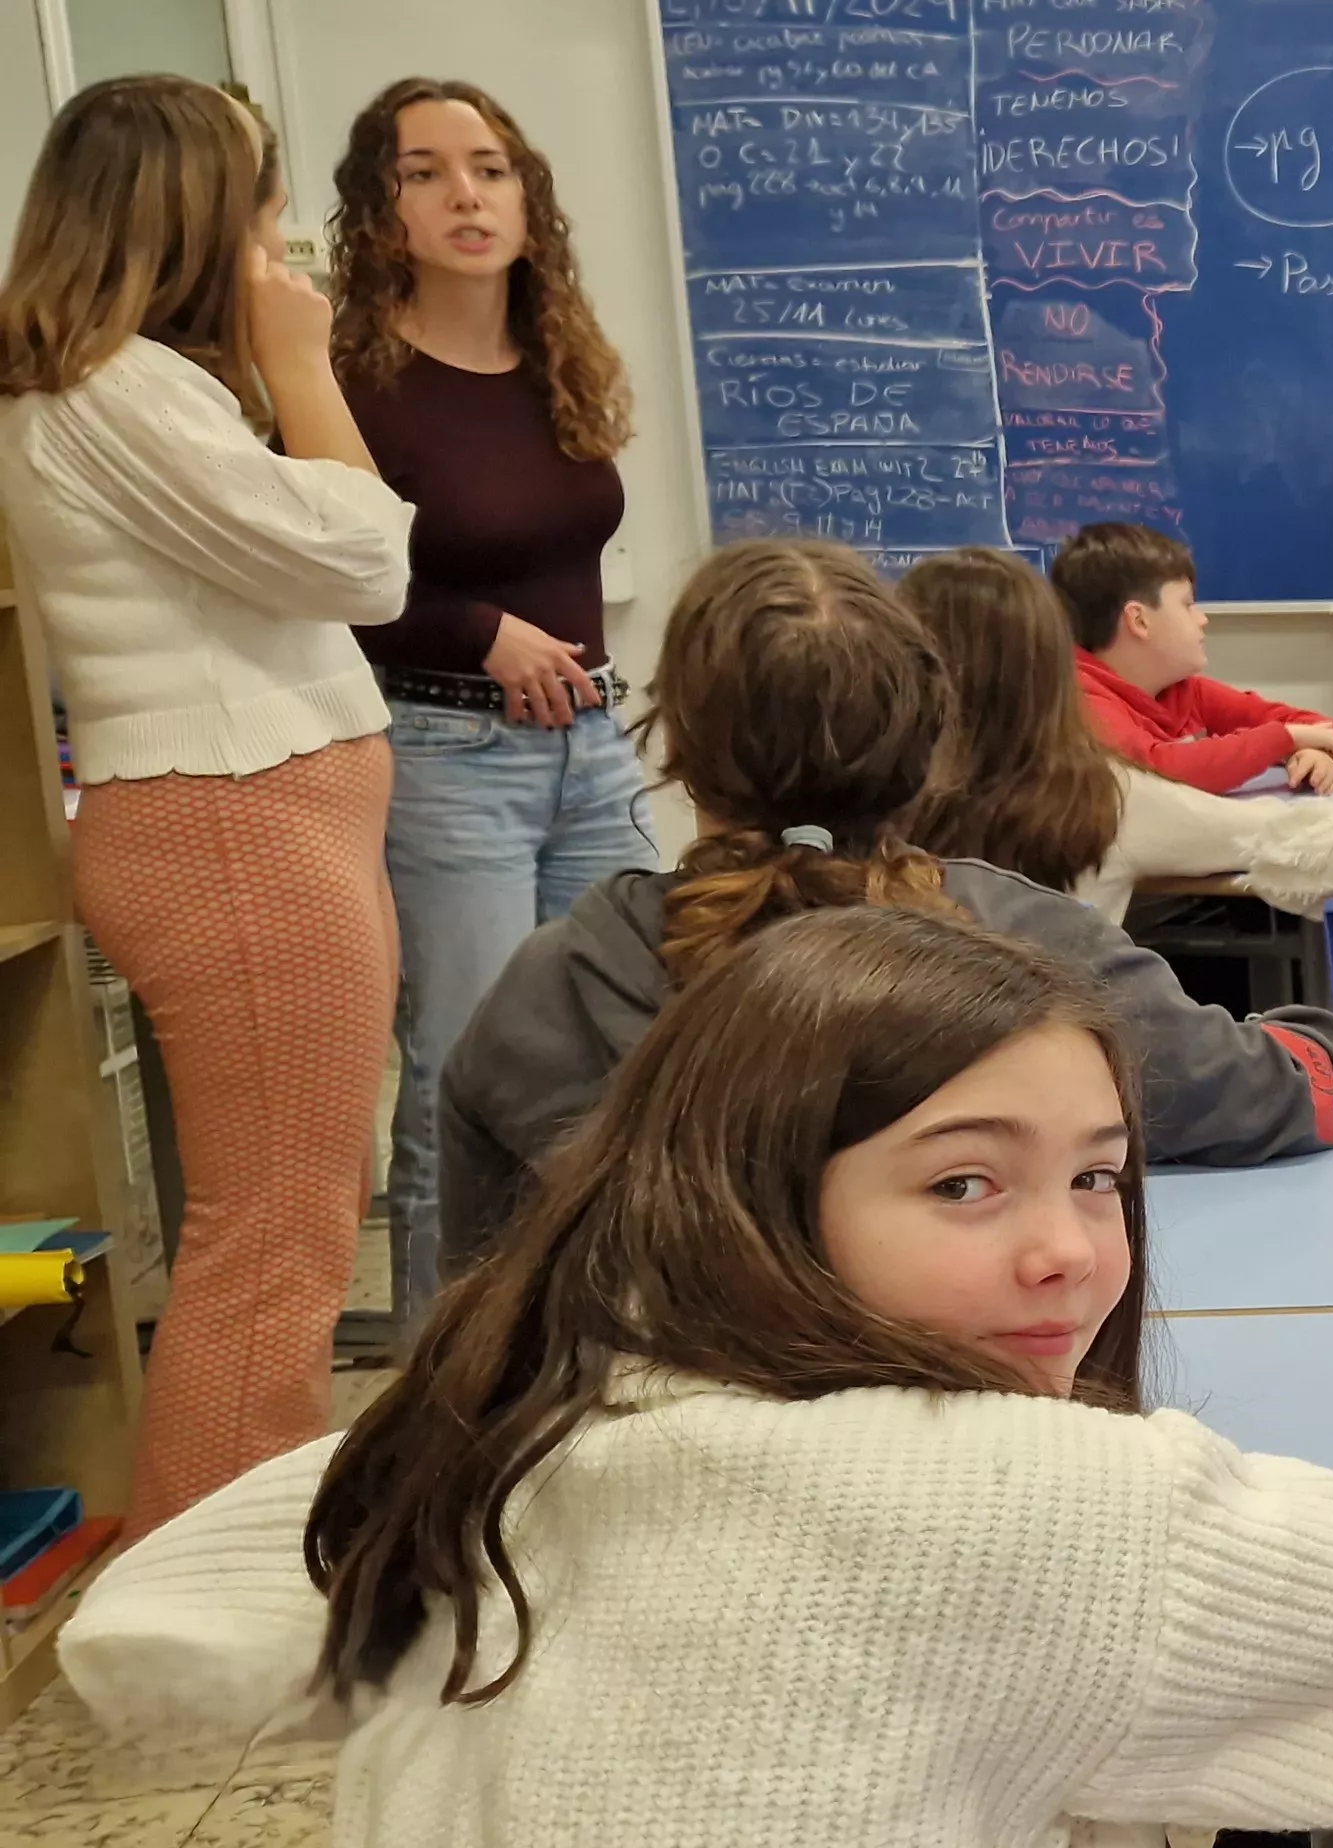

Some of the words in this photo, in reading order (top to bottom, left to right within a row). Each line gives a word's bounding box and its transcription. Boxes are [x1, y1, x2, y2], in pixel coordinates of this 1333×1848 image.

[1008, 23, 1184, 59] PERDONAR
[991, 87, 1128, 117] TENEMOS
[993, 206, 1119, 235] Compartir
[1014, 240, 1167, 273] VIVIR
[1044, 303, 1090, 336] NO
[850, 381, 913, 407] DE
